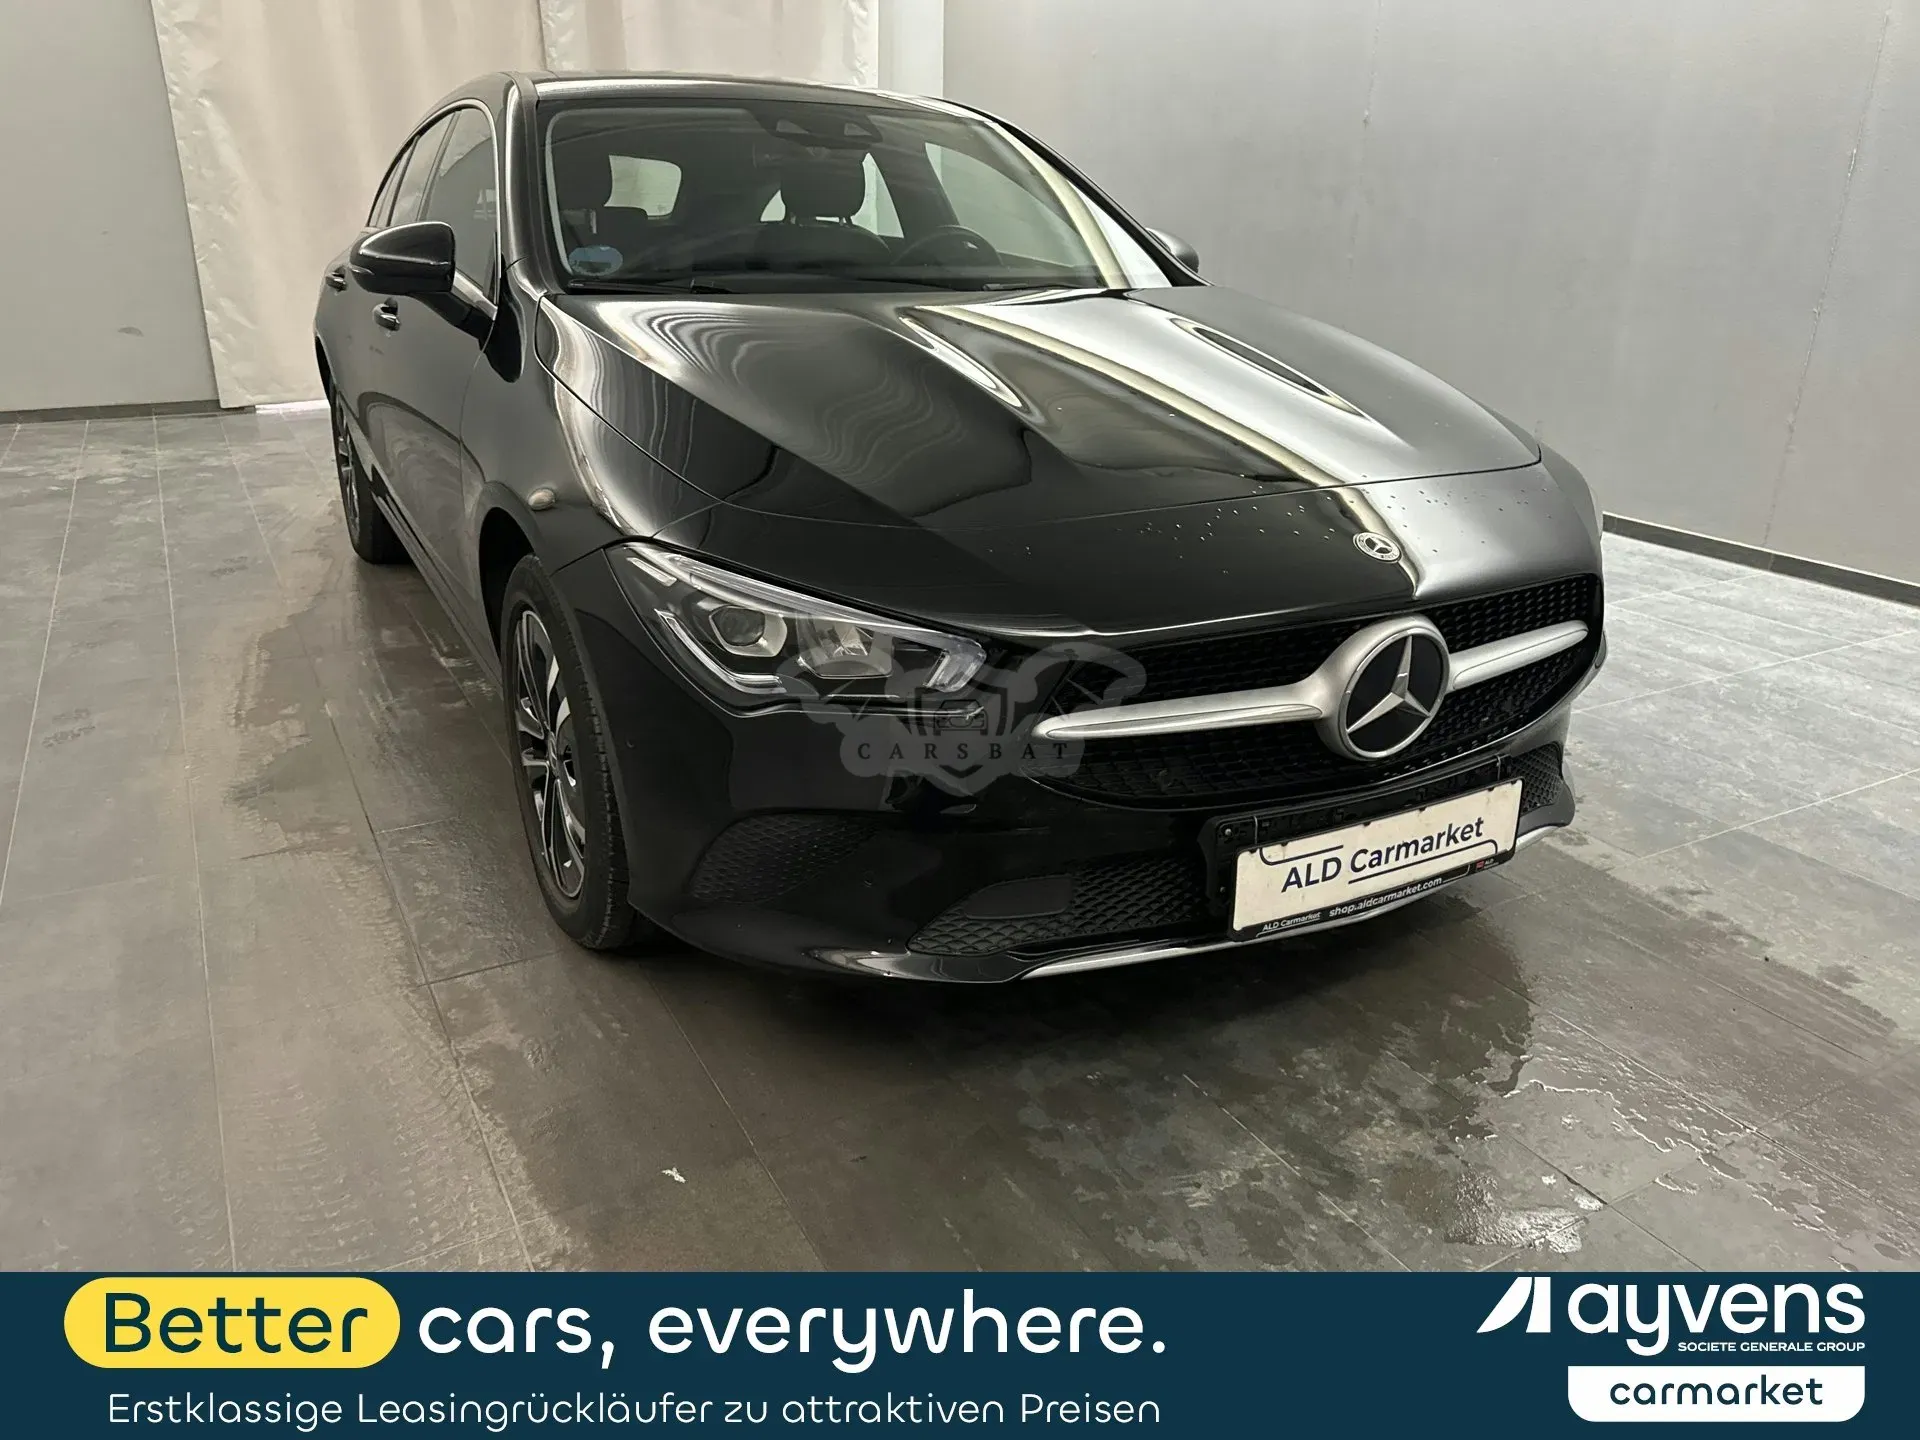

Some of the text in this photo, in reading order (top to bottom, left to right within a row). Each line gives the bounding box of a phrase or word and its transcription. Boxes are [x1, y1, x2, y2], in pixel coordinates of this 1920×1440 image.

[1281, 816, 1485, 893] ALD Carmarket
[1328, 877, 1442, 917] shop.aldcarmarket.com
[1262, 911, 1322, 932] ALD Carmarket
